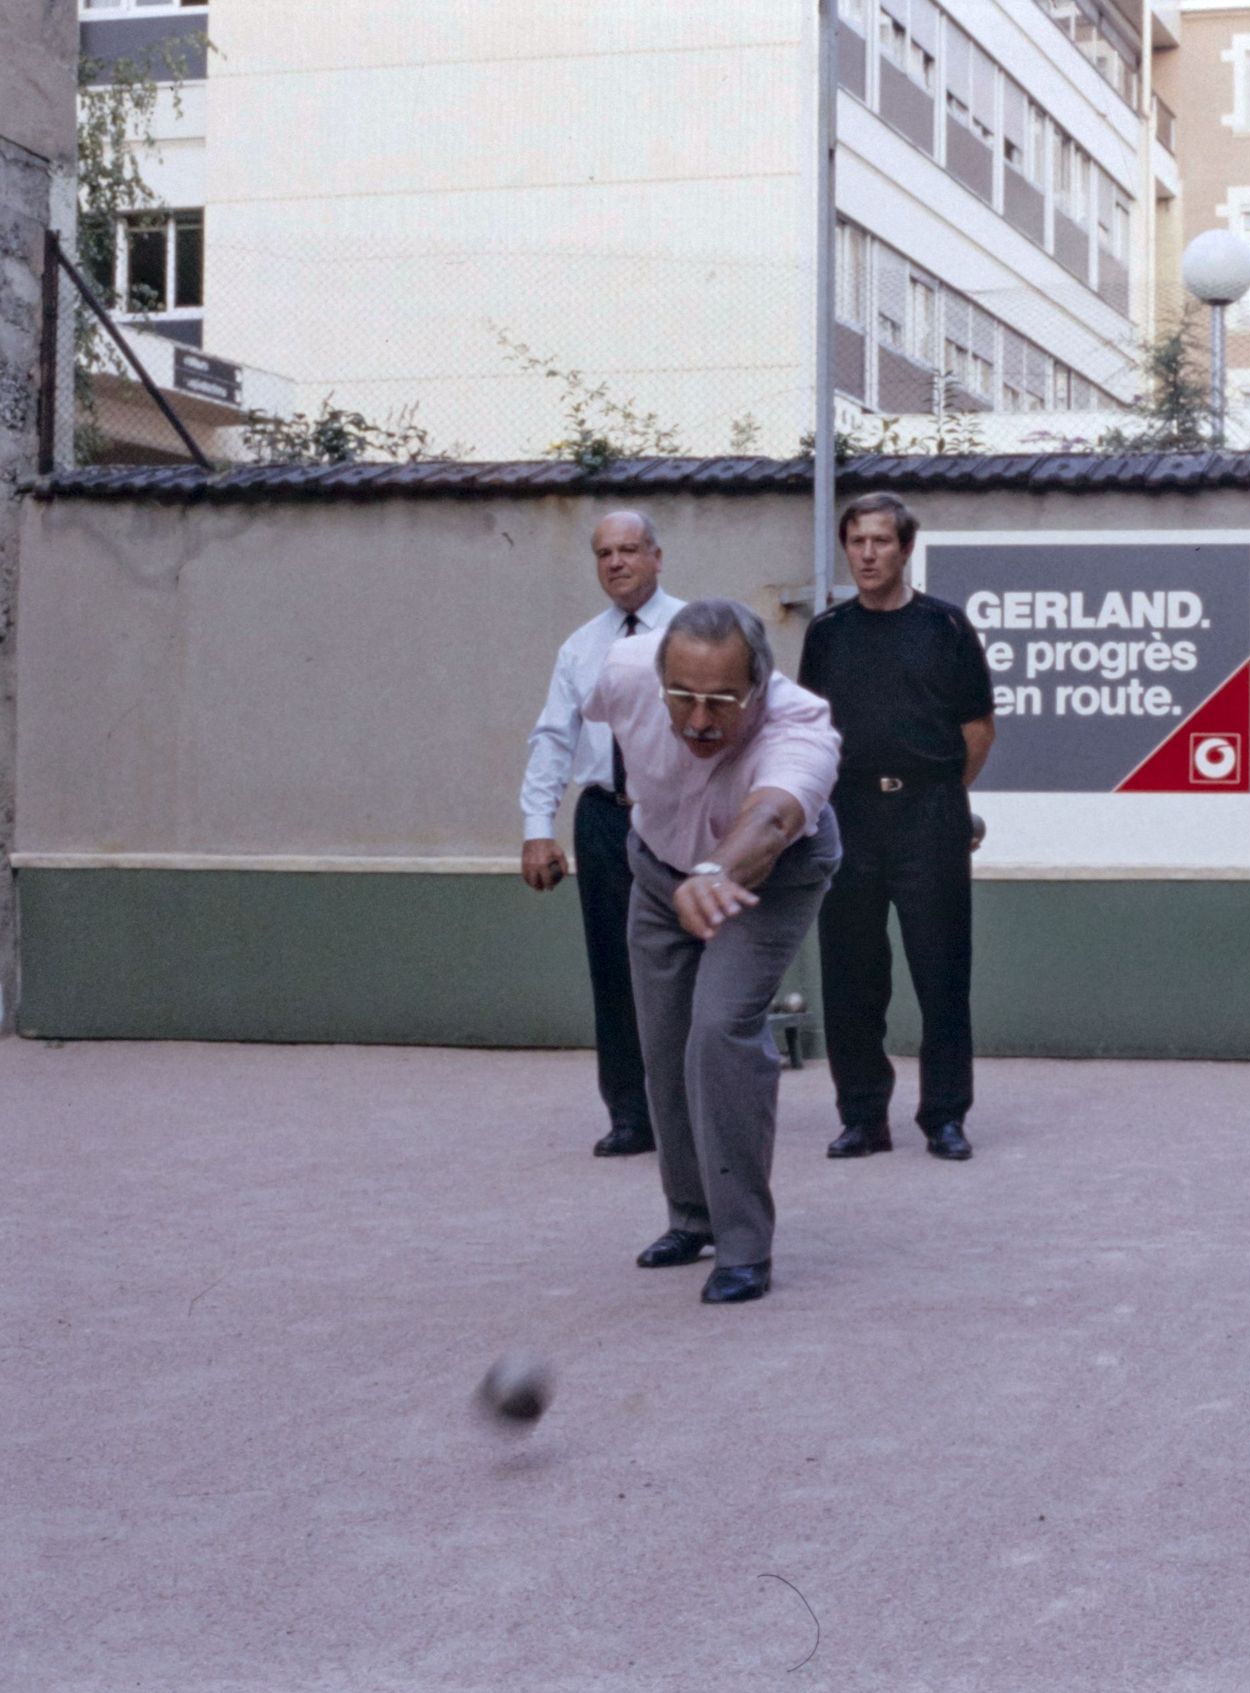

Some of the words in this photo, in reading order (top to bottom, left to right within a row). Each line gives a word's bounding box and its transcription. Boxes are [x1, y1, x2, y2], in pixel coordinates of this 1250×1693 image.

[965, 590, 1211, 630] GERLAND.
[977, 632, 1015, 673] e
[1026, 630, 1198, 680] progrès
[993, 685, 1043, 716] en
[1055, 677, 1183, 717] route.
